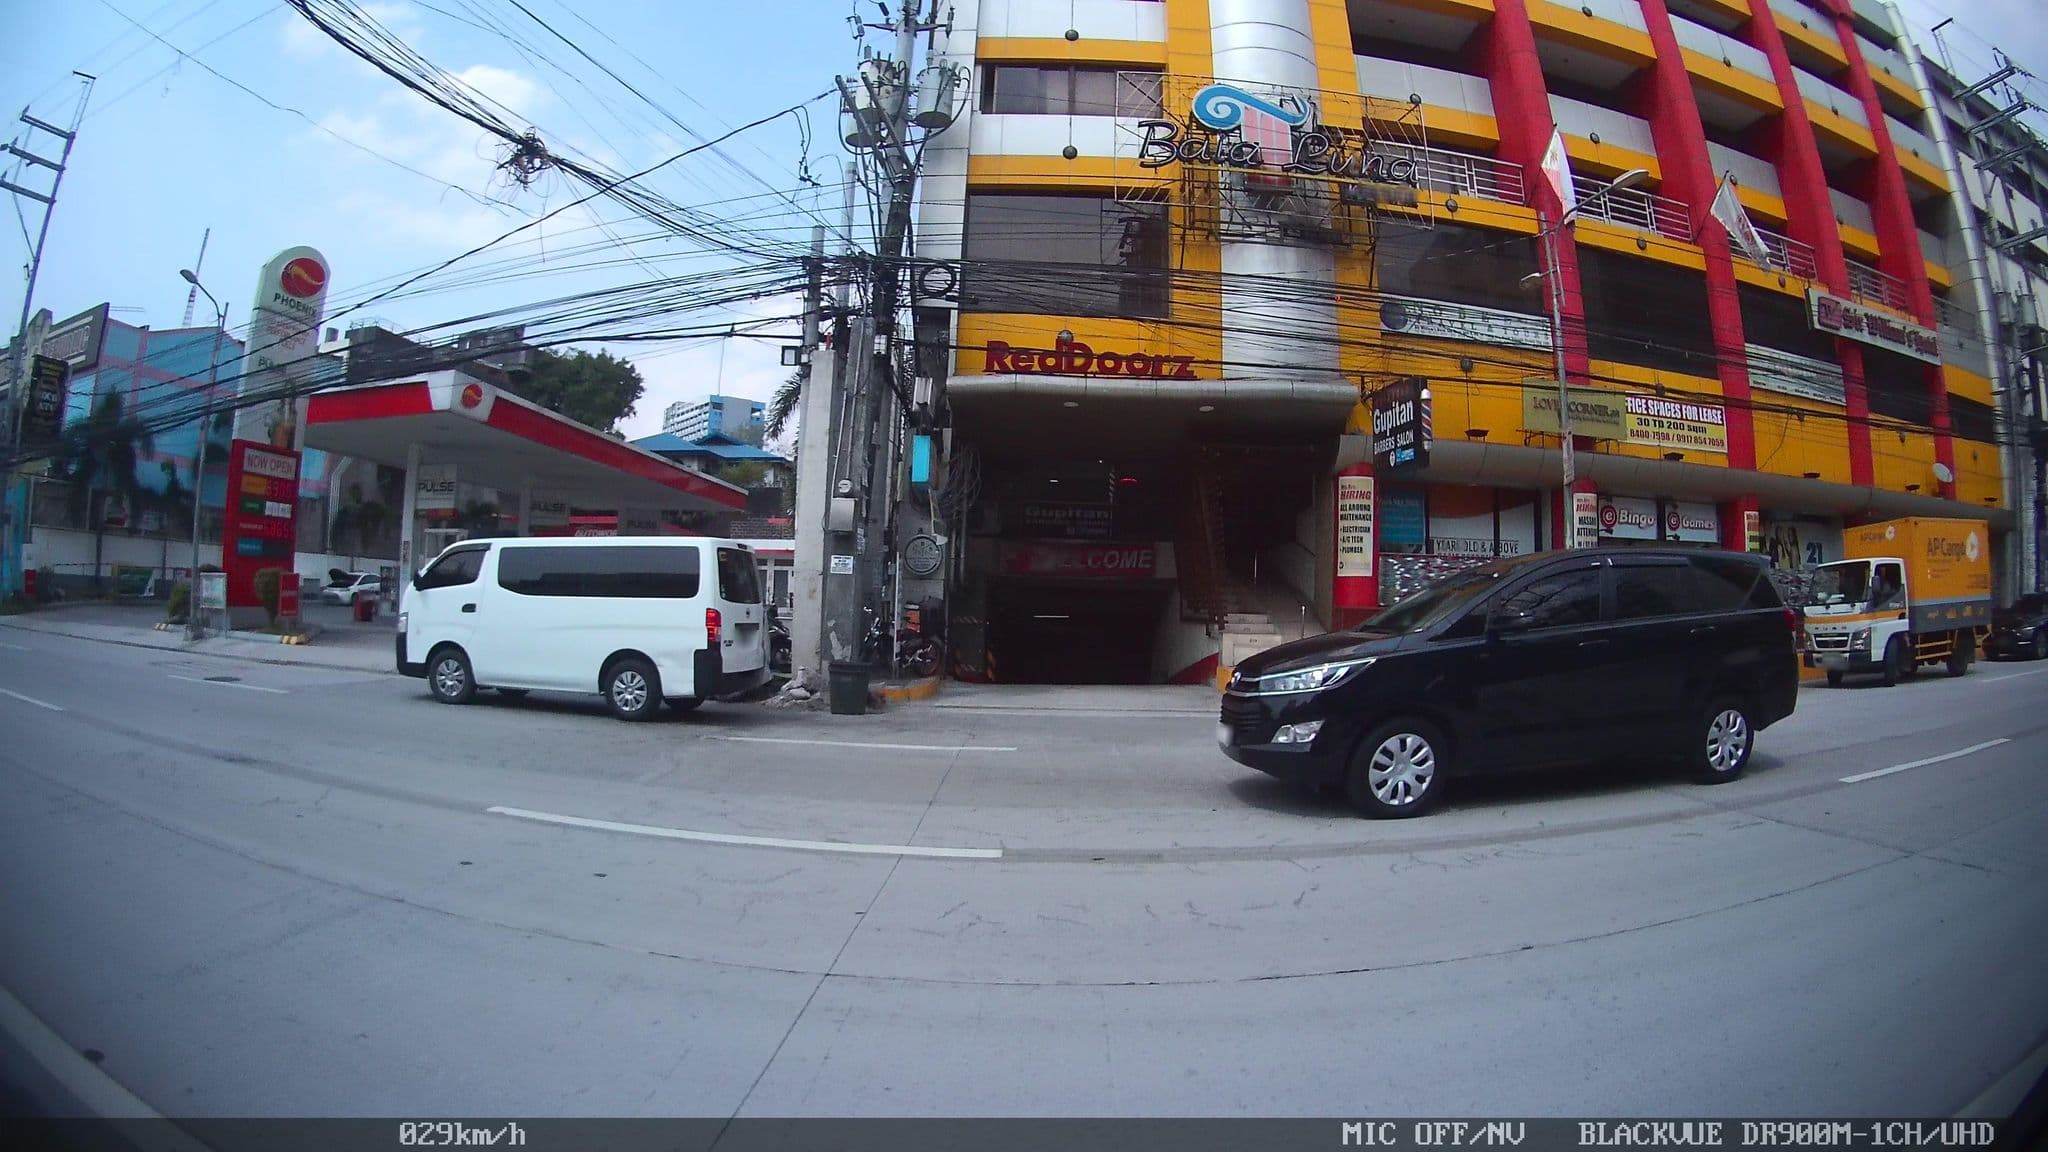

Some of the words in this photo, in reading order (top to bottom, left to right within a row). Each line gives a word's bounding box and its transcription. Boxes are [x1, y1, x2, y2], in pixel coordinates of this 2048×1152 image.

[985, 337, 1196, 377] RedDoorz
[1374, 400, 1414, 436] Gupitan
[1648, 399, 1680, 418] SPACES
[1682, 405, 1698, 420] FOR
[1700, 408, 1723, 424] LEASE
[1637, 417, 1650, 426] 30
[1667, 421, 1685, 430] 200
[1397, 429, 1414, 447] SALON
[247, 454, 268, 470] NOW
[271, 458, 293, 475] OPEN
[418, 480, 454, 493] PULSE
[1340, 490, 1372, 500] HIRING
[1349, 504, 1370, 512] AROUND
[1619, 509, 1654, 529] Bingo
[1683, 518, 1714, 530] Games
[1352, 536, 1364, 544] TECH
[1806, 542, 1823, 564] 21
